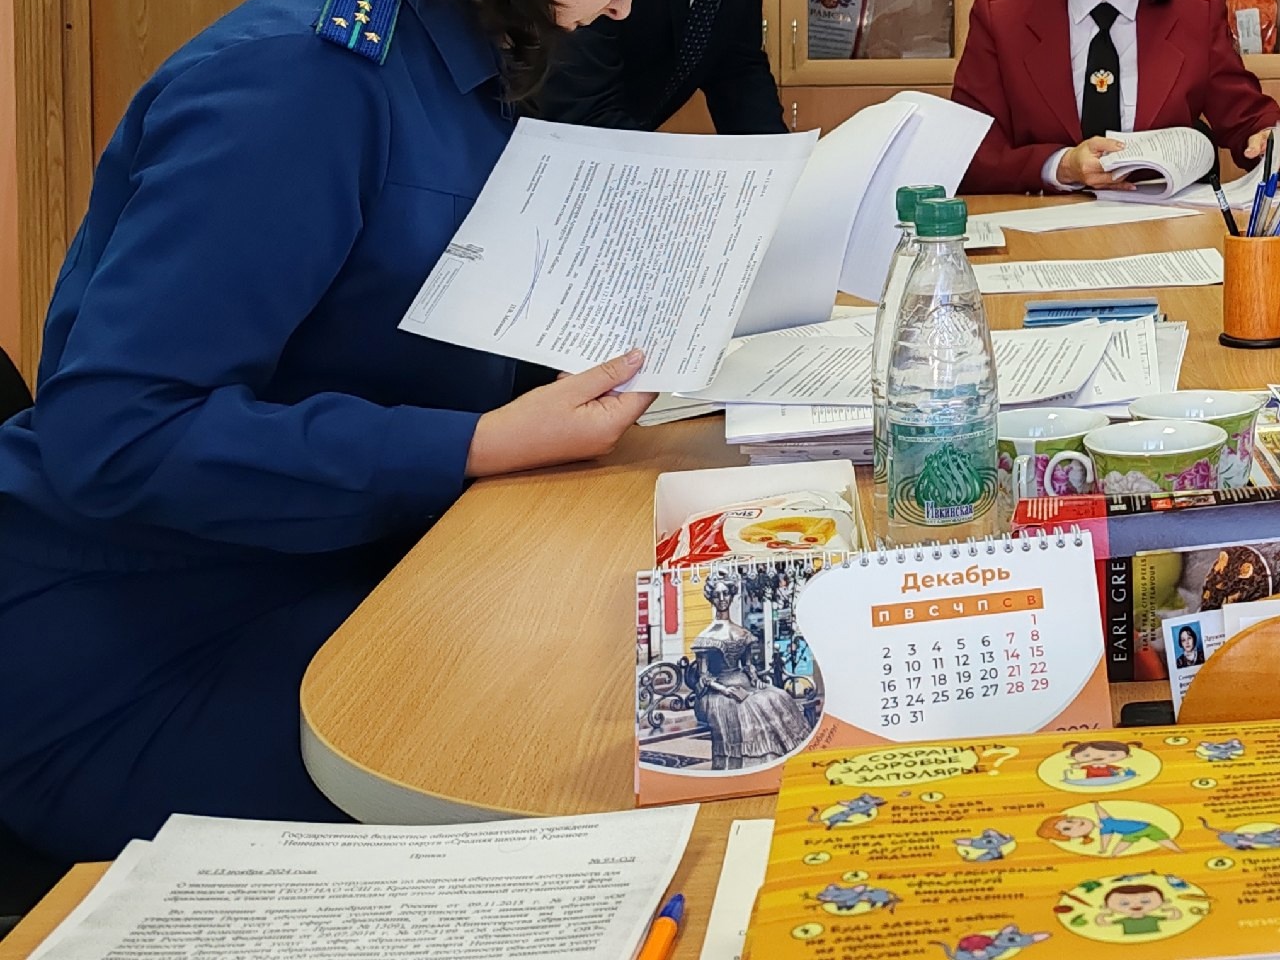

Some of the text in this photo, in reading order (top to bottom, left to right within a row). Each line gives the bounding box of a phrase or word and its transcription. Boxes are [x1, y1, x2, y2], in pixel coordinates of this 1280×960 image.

[926, 501, 974, 518] Ивкинская
[901, 565, 1011, 593] Декабрь
[879, 595, 1037, 623] П В С Ч П С В
[1031, 614, 1037, 625] 1
[1111, 561, 1128, 662] EARL GRE
[882, 630, 1040, 659] 2 3 4 5 6 7 8
[882, 646, 1044, 675] 9 10 11 12 13 14 15
[881, 662, 1047, 693] 16 17 18 19 20 21 22
[881, 678, 1049, 710] 23 24 25 26 27 28 29
[881, 710, 924, 727] 30 31
[811, 757, 858, 769] КАК
[868, 744, 1006, 763] СОХРАНИТЬ
[840, 756, 963, 775] ЗДОРОВЬЕ
[829, 765, 989, 787] В ЗАПОЛЯРЬЕ
[281, 830, 368, 840] Государственное
[540, 823, 600, 835] учреждение
